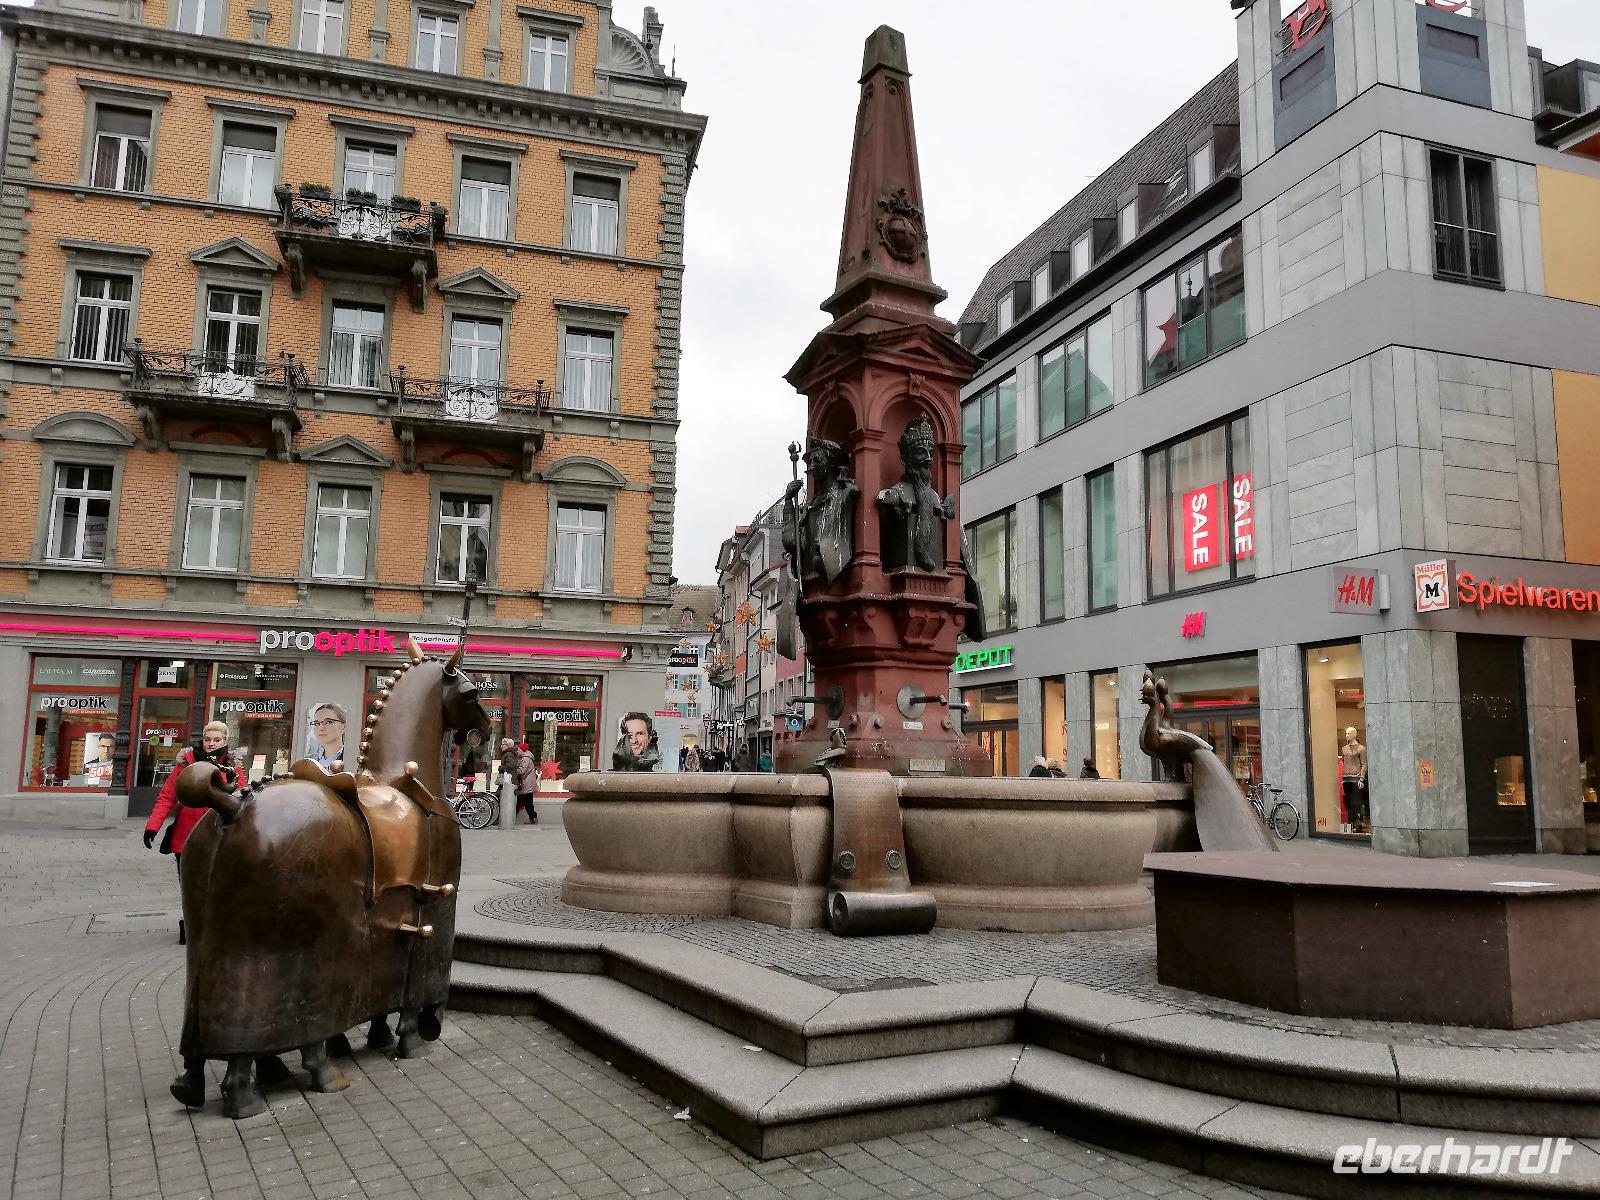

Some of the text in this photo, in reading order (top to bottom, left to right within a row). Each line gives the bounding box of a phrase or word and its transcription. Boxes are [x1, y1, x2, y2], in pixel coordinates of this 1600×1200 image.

[1191, 492, 1209, 566] SALE
[1233, 478, 1253, 555] SALE
[1416, 563, 1446, 574] Müller
[1337, 575, 1375, 607] H&M
[1424, 582, 1440, 599] M
[1458, 571, 1600, 613] Spielwaren
[1181, 611, 1206, 638] H&M
[955, 645, 1013, 671] DEPOT
[475, 681, 498, 689] BOSS
